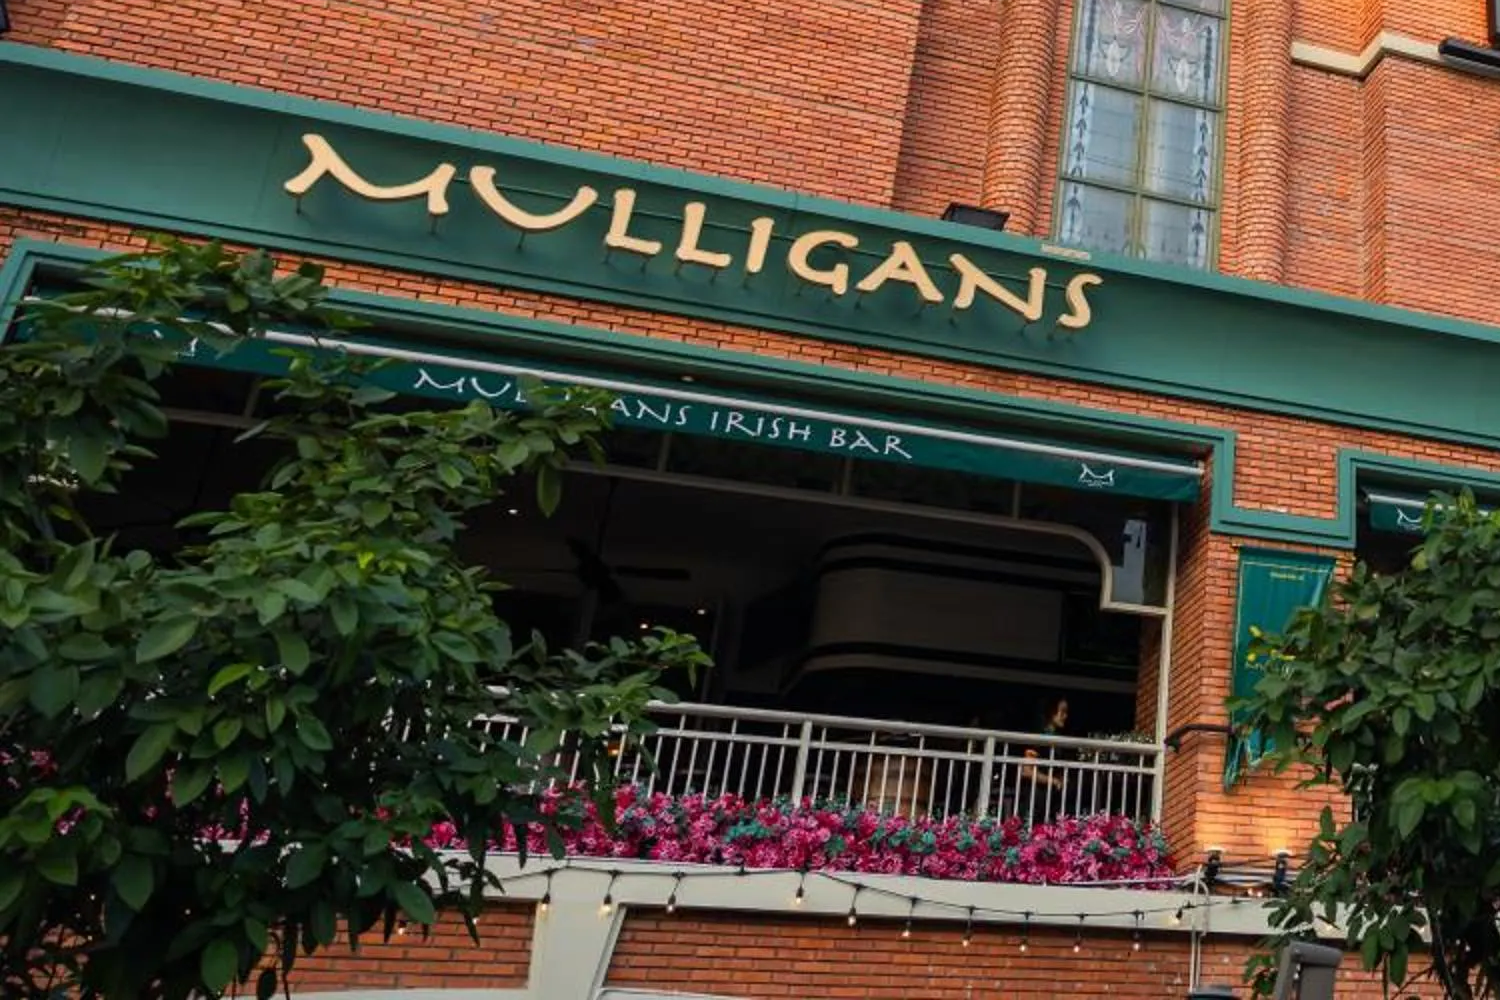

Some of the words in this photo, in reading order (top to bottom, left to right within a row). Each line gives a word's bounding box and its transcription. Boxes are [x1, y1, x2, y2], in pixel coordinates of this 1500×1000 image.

[284, 133, 1102, 329] MULLIGANS
[710, 411, 811, 441] IRISH
[829, 427, 912, 460] BAR
